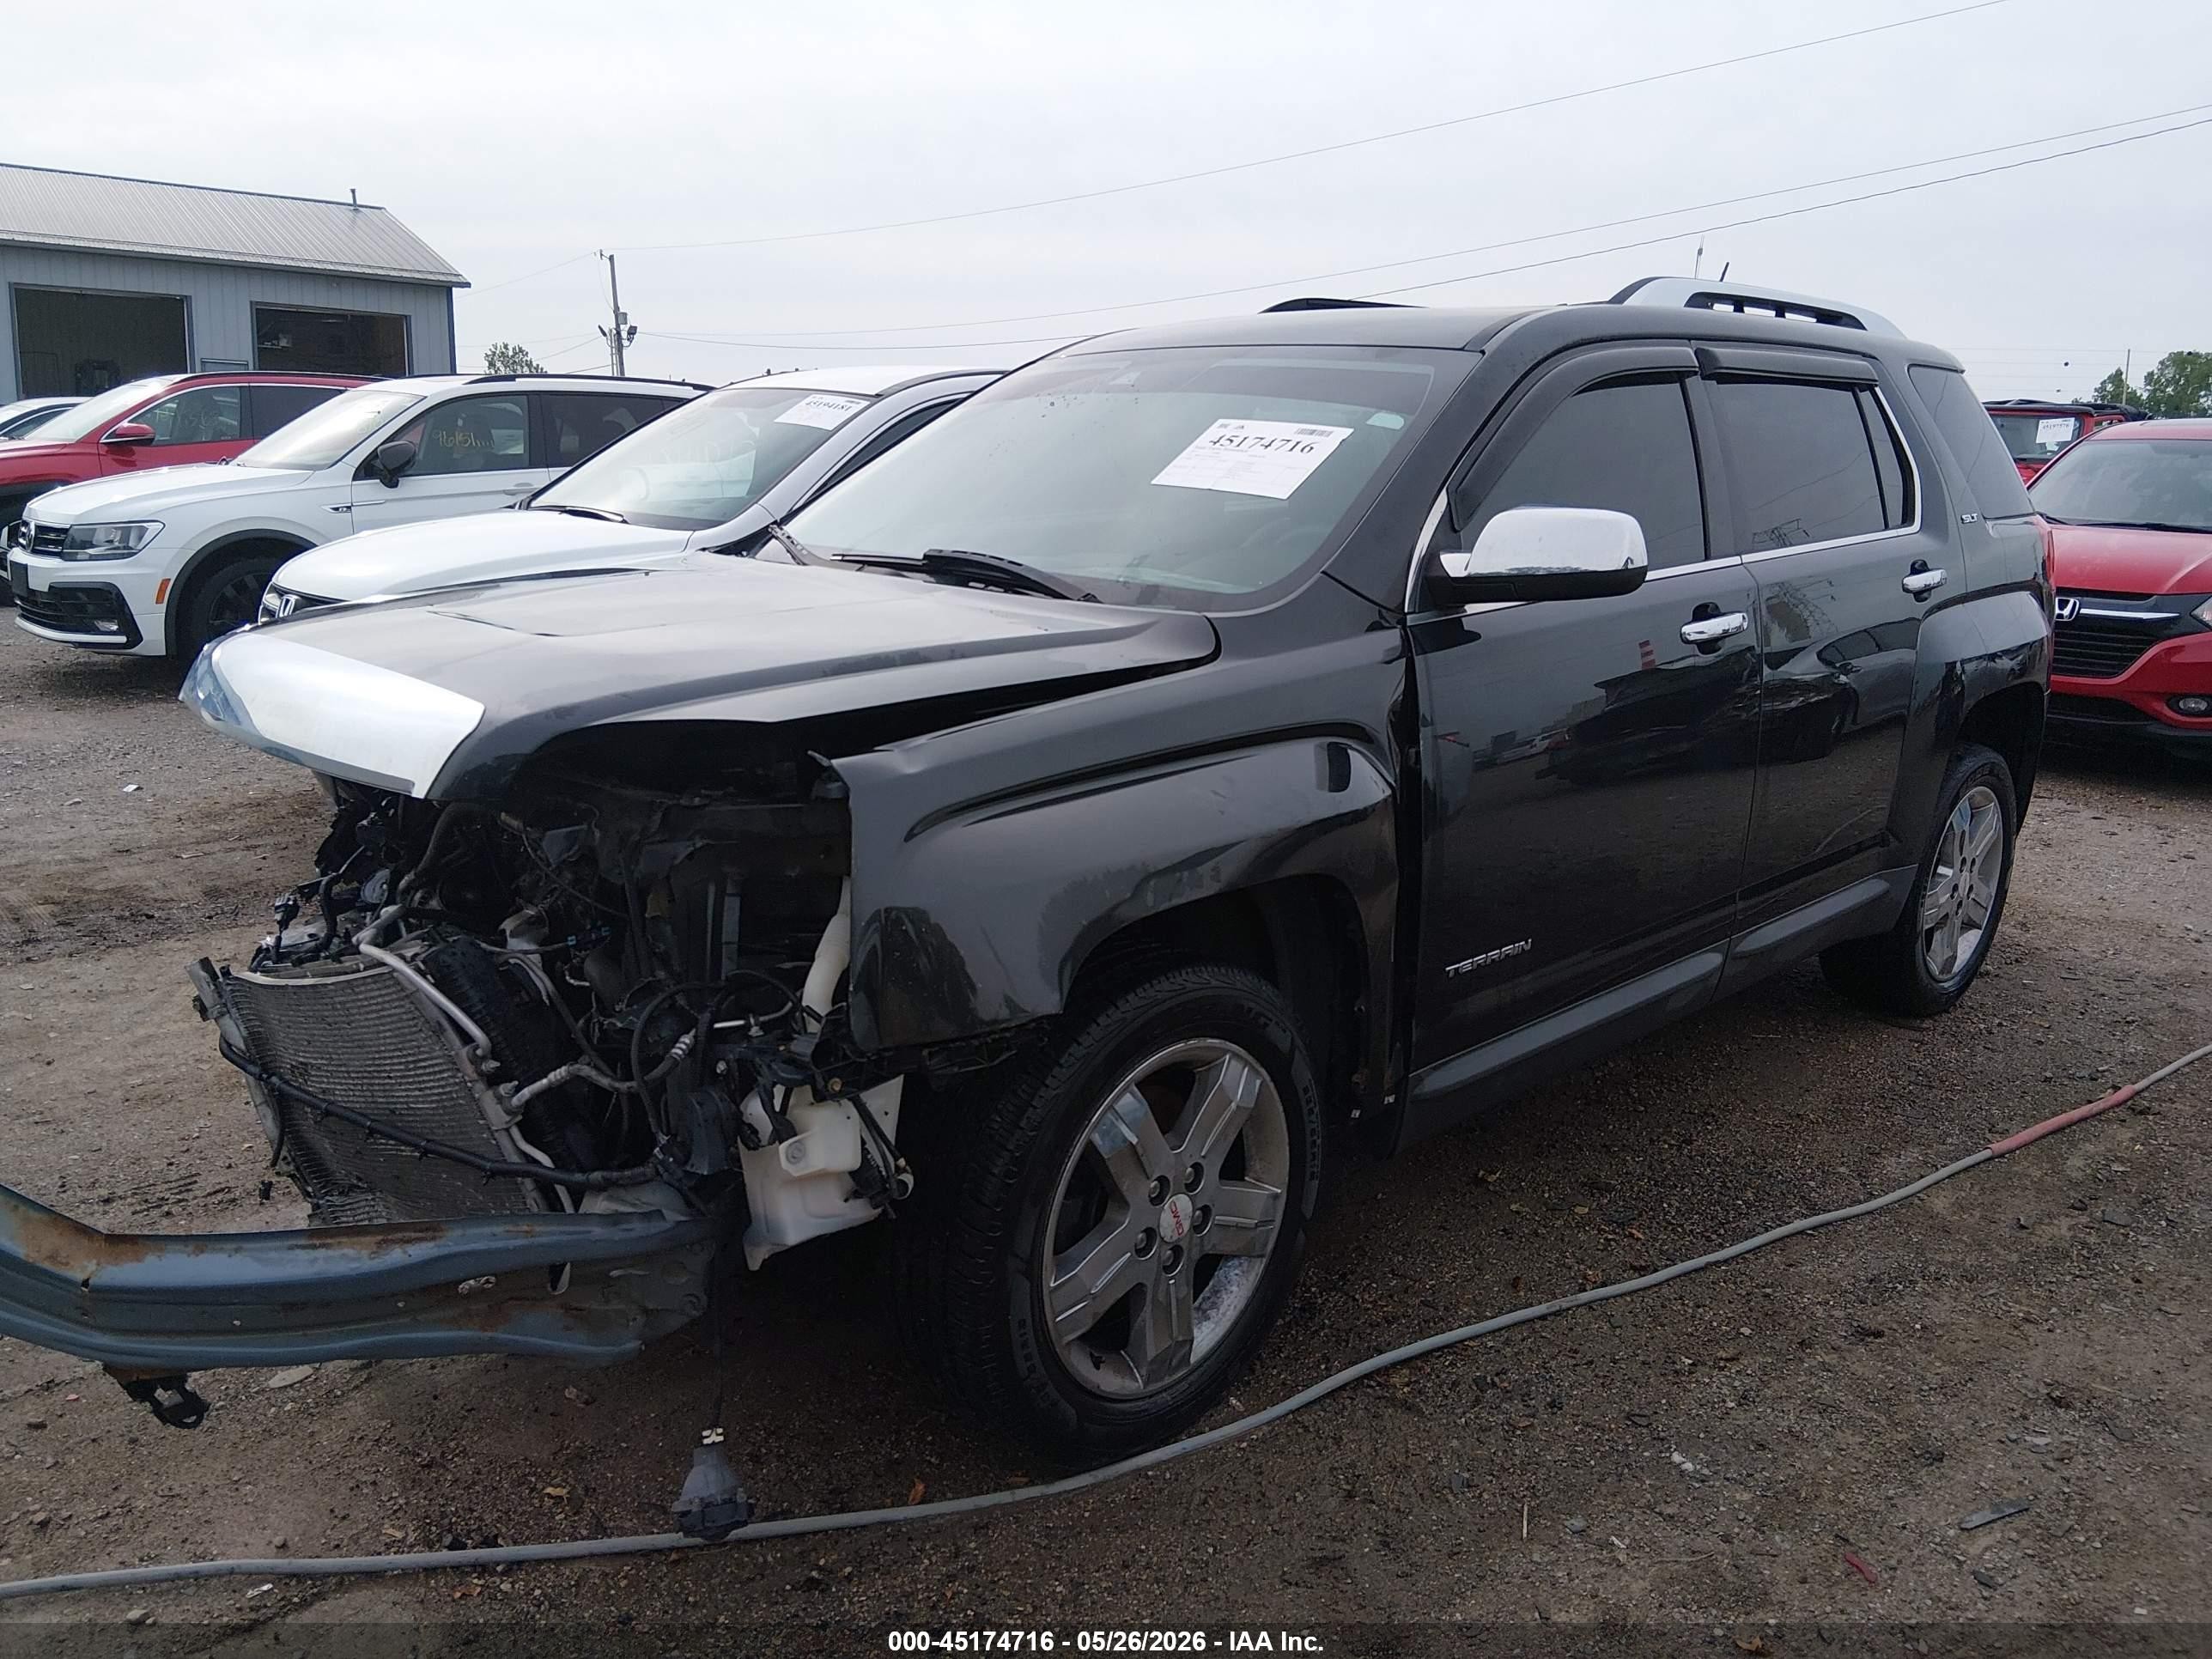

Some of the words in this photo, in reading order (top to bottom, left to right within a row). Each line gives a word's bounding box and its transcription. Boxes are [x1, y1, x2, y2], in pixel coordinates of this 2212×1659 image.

[1209, 434, 1320, 454] 45174716
[1961, 513, 1978, 523] SLT
[1445, 938, 1533, 978] TERRAIN
[1170, 1199, 1184, 1237] GMC
